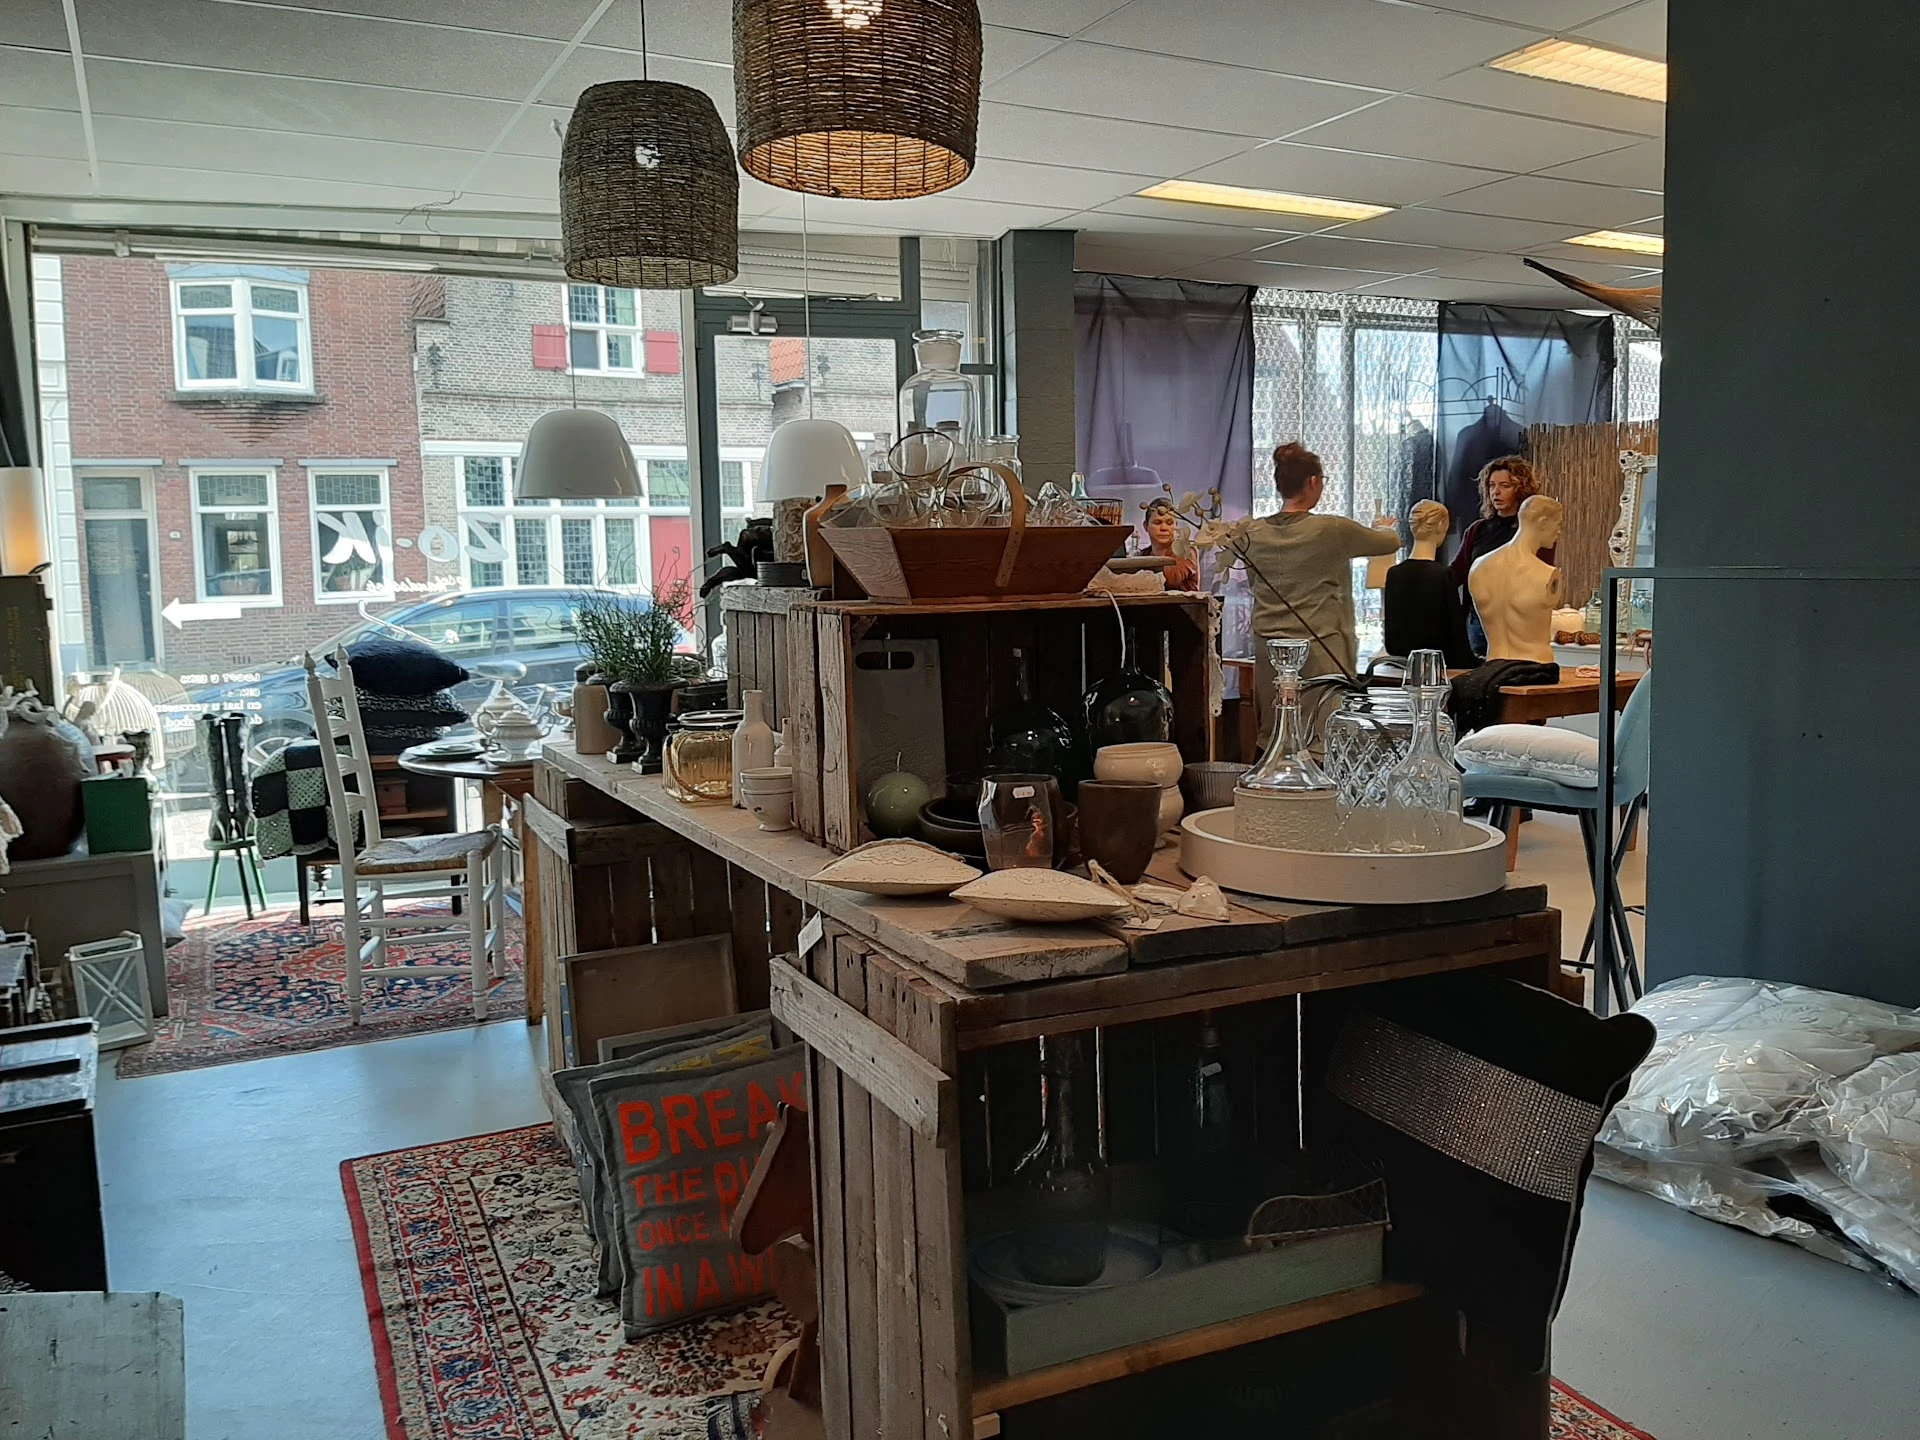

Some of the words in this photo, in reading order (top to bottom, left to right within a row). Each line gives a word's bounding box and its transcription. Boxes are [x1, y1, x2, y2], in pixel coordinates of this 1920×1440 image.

[630, 1168, 706, 1208] THE
[637, 1212, 711, 1251] ONCE
[642, 1261, 684, 1317] IN
[695, 1257, 724, 1307] A
